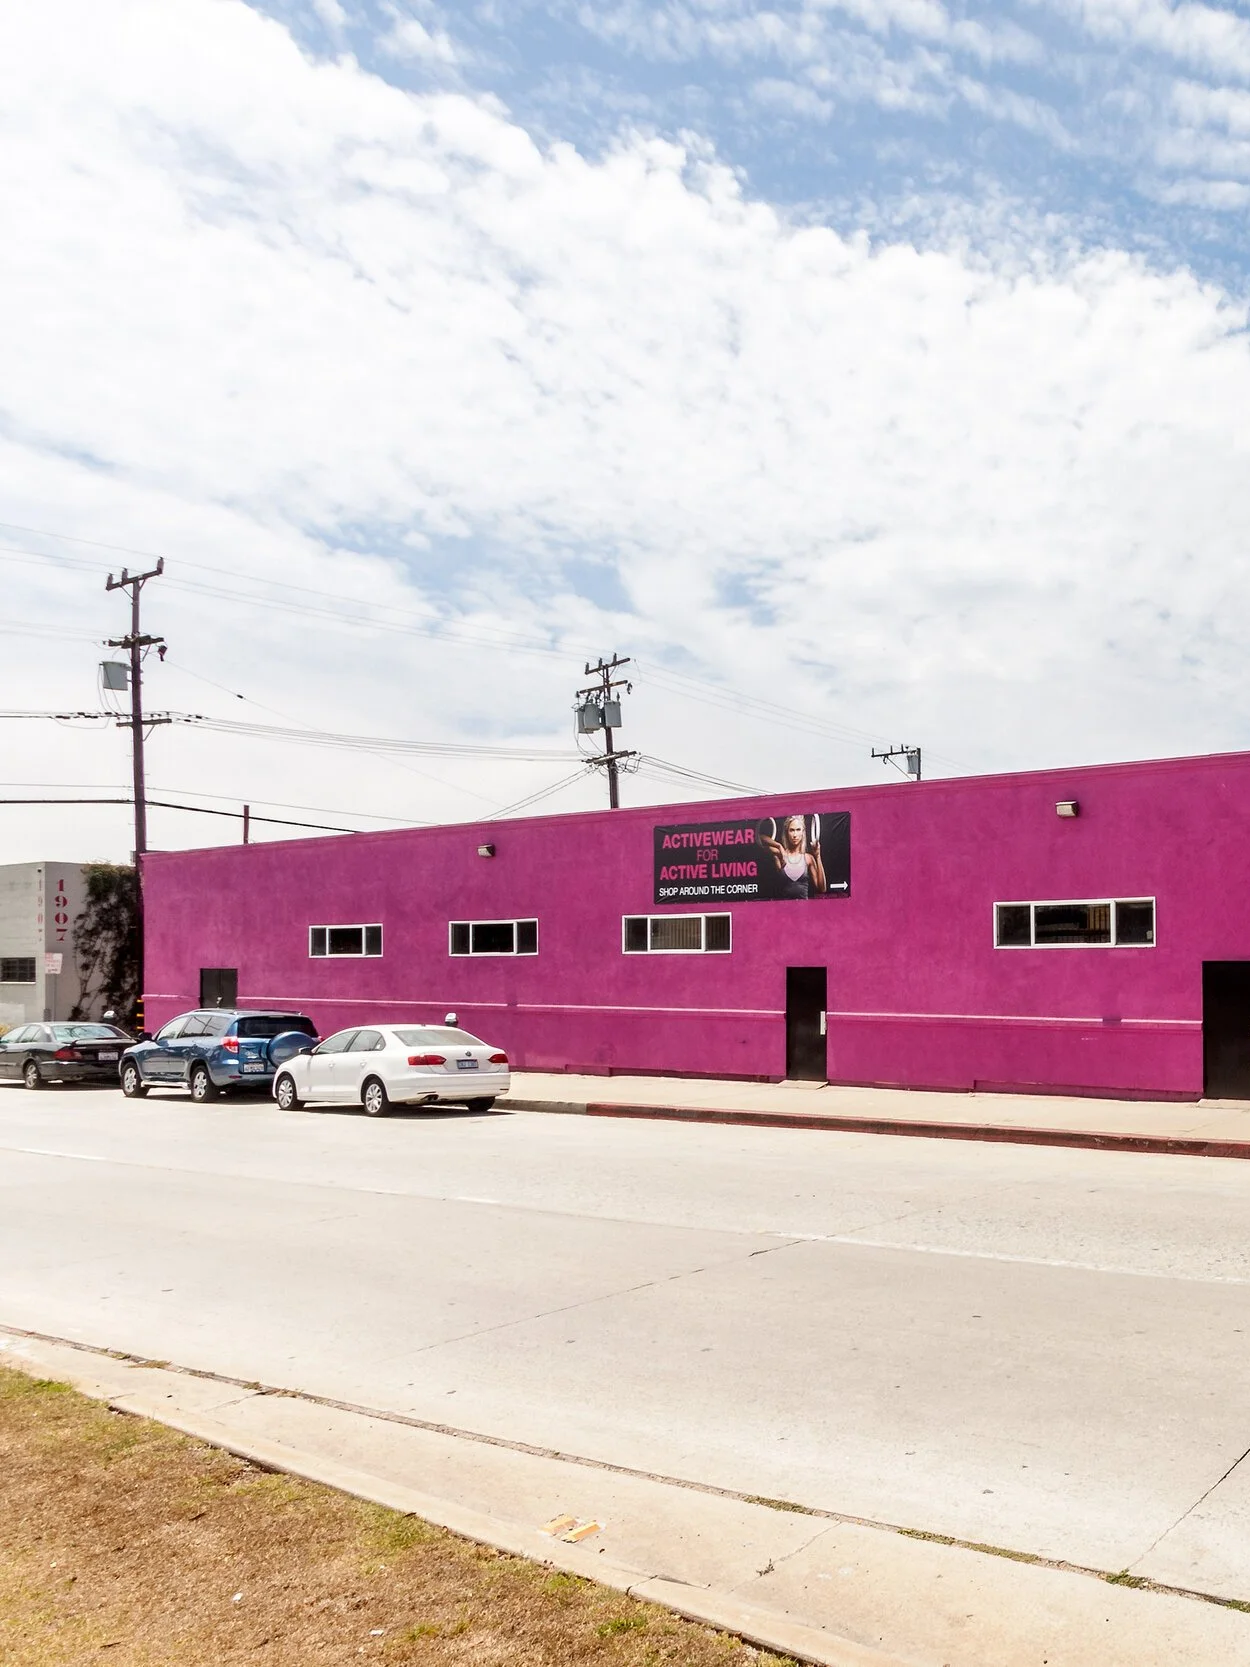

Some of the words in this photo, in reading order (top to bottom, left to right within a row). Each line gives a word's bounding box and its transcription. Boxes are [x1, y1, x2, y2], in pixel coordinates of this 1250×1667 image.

[662, 829, 755, 849] ACTIVEWEAR
[696, 849, 719, 862] FOR
[660, 864, 708, 881] ACTIVE
[711, 862, 758, 878] LIVING
[659, 887, 678, 897] SHOP
[679, 886, 709, 896] AROUND
[711, 885, 726, 895] THE
[726, 884, 758, 894] CORNER
[54, 879, 69, 942] 1907
